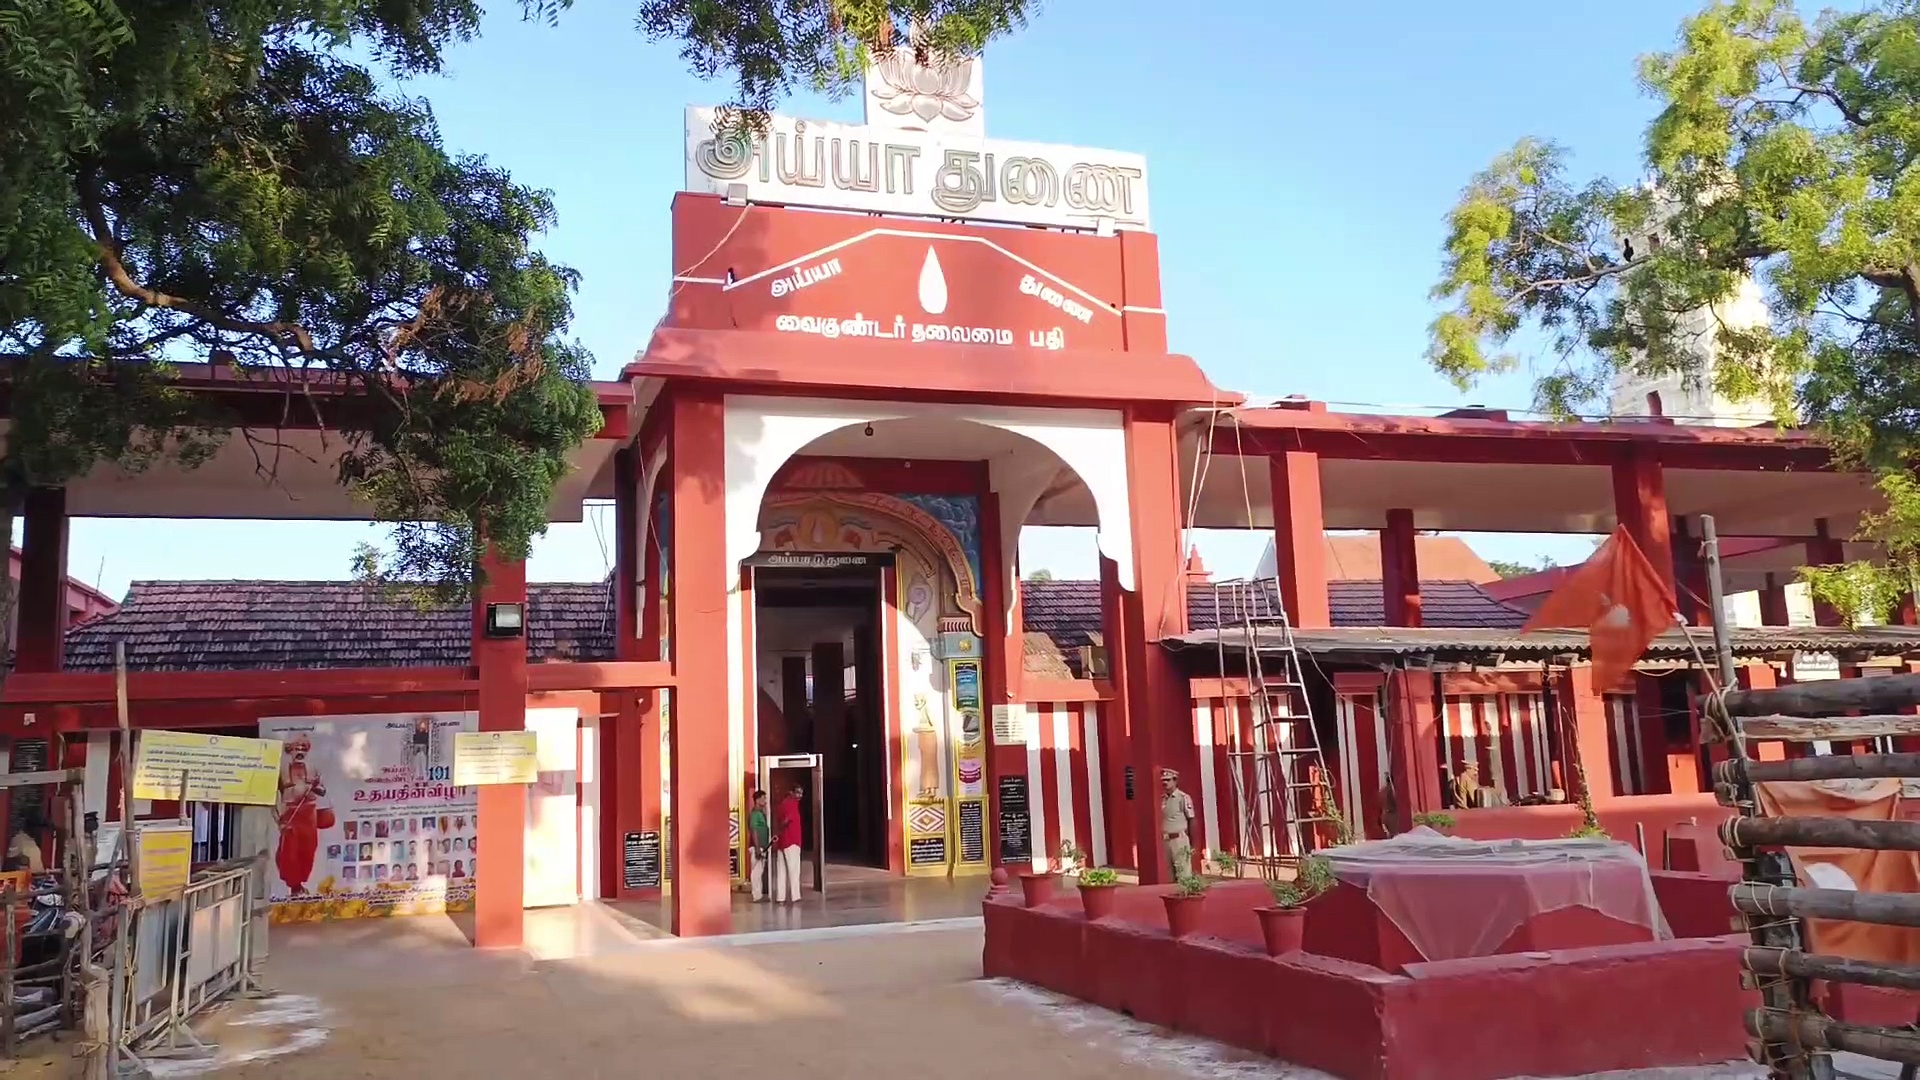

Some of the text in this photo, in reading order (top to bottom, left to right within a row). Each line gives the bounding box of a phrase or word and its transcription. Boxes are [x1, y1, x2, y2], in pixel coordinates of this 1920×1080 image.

[696, 121, 1143, 214] அய்யா துணை
[770, 258, 1095, 325] அய்யா துணை
[775, 312, 1066, 351] வைகுண்டர் தலைமை பதி
[428, 765, 451, 781] 191
